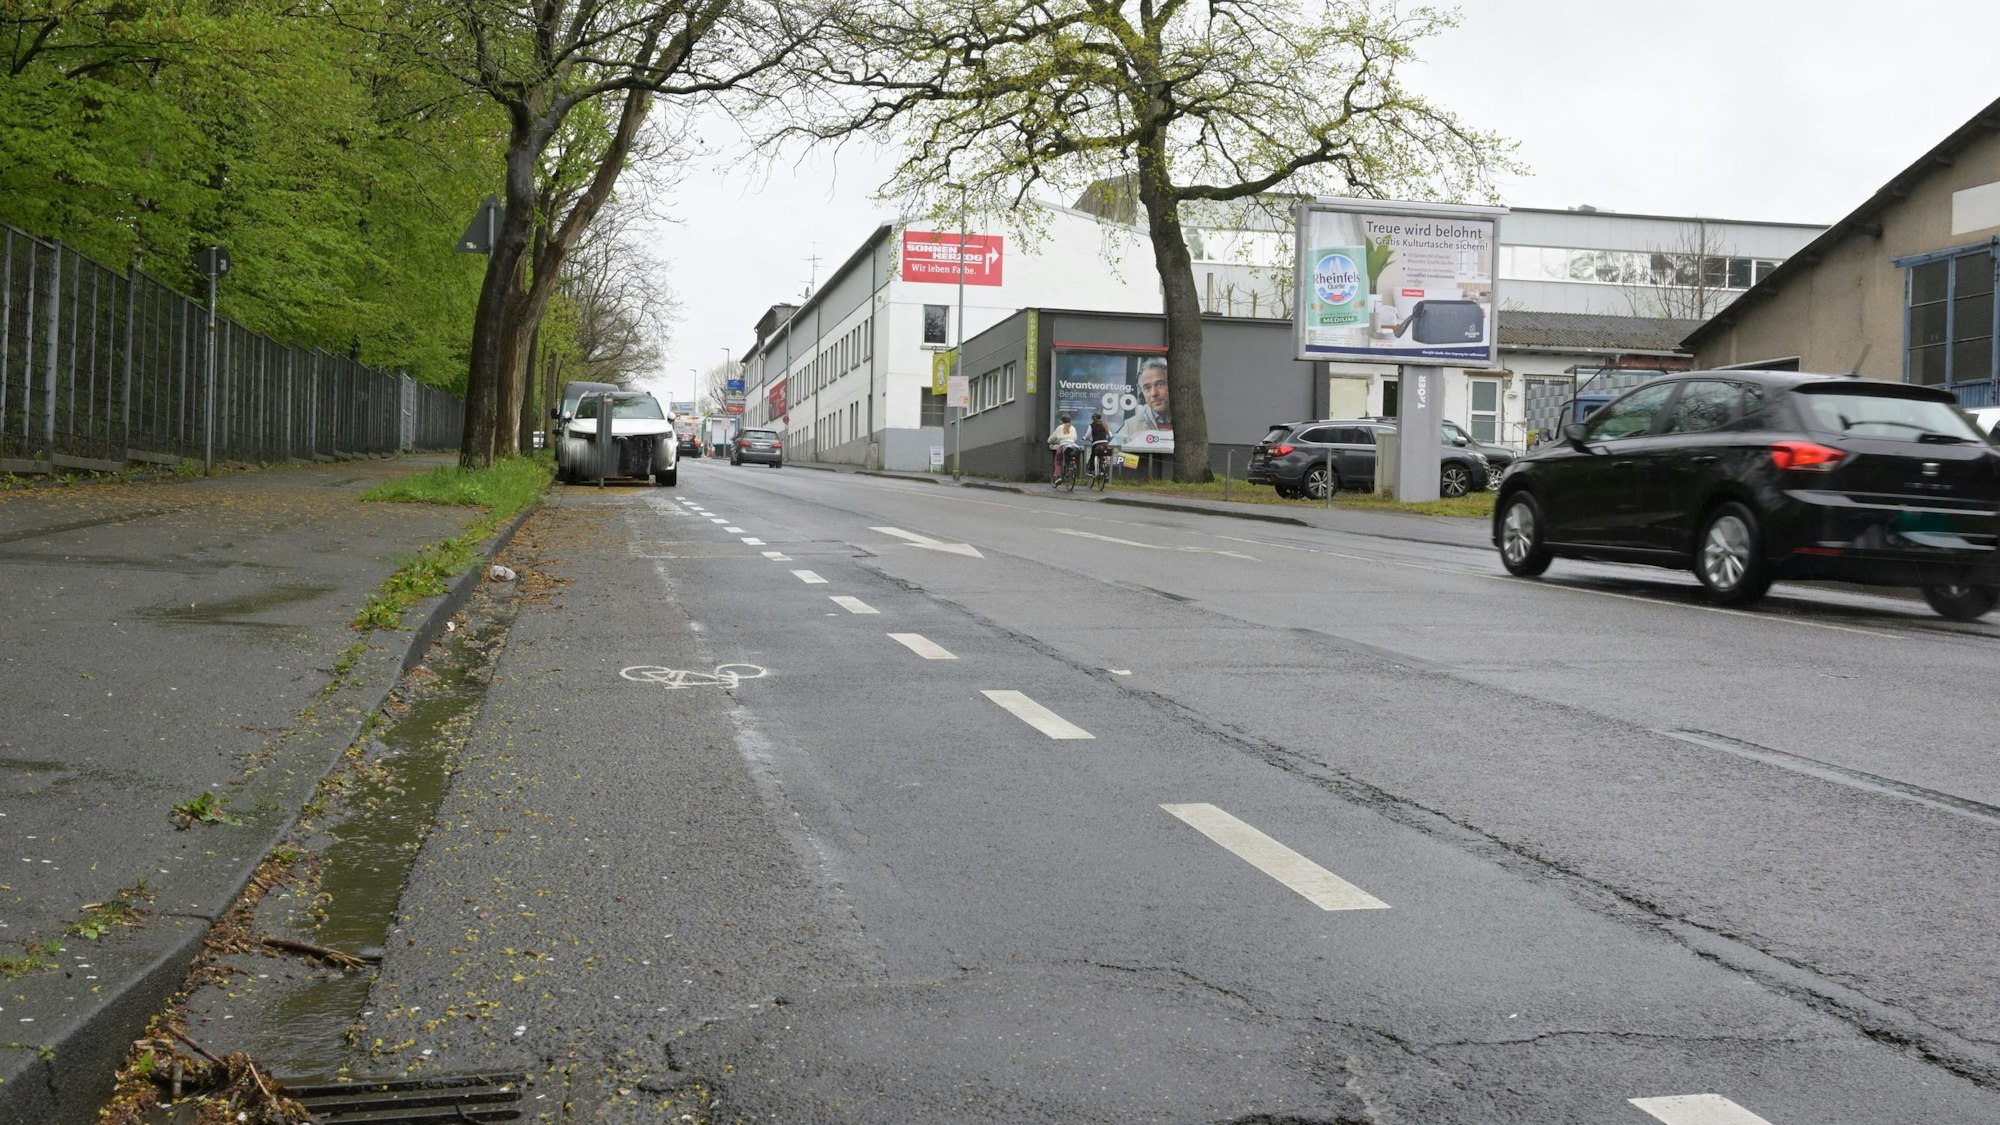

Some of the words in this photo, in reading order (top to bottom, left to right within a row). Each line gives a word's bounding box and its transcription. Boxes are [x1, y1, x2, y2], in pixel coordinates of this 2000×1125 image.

[1366, 221, 1401, 234] Treue
[1404, 224, 1431, 236] wird
[1436, 224, 1482, 239] belohnt
[906, 244, 957, 253] SONNEN
[1375, 237, 1400, 246] Gratis
[1402, 239, 1453, 249] Kulturtasche
[1455, 240, 1488, 251] sichern!
[911, 264, 926, 272] Wir
[928, 264, 950, 273] leben
[952, 266, 977, 275] Fabe.
[1312, 271, 1361, 285] Rheinfels
[1059, 380, 1134, 393] Verantwortung.
[1059, 390, 1087, 399] Beginnt
[1101, 393, 1138, 415] go
